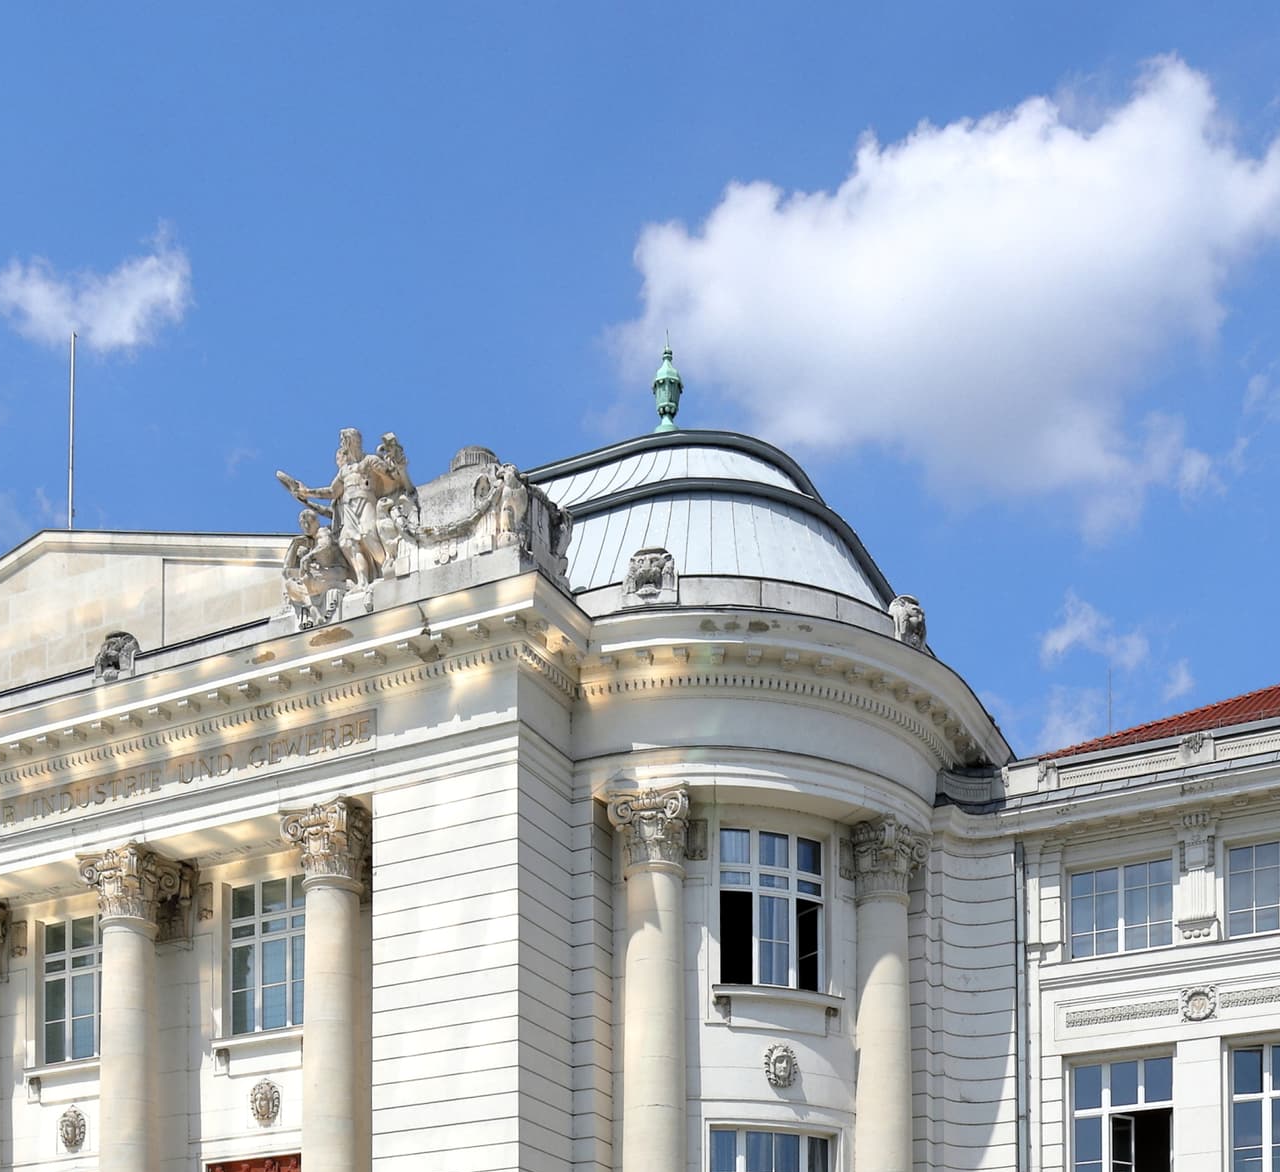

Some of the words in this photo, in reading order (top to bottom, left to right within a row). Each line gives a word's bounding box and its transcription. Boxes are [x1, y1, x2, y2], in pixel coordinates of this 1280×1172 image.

[32, 768, 162, 821] INDUSTRIE
[178, 752, 233, 784] UND
[248, 719, 371, 769] GEWERBE
